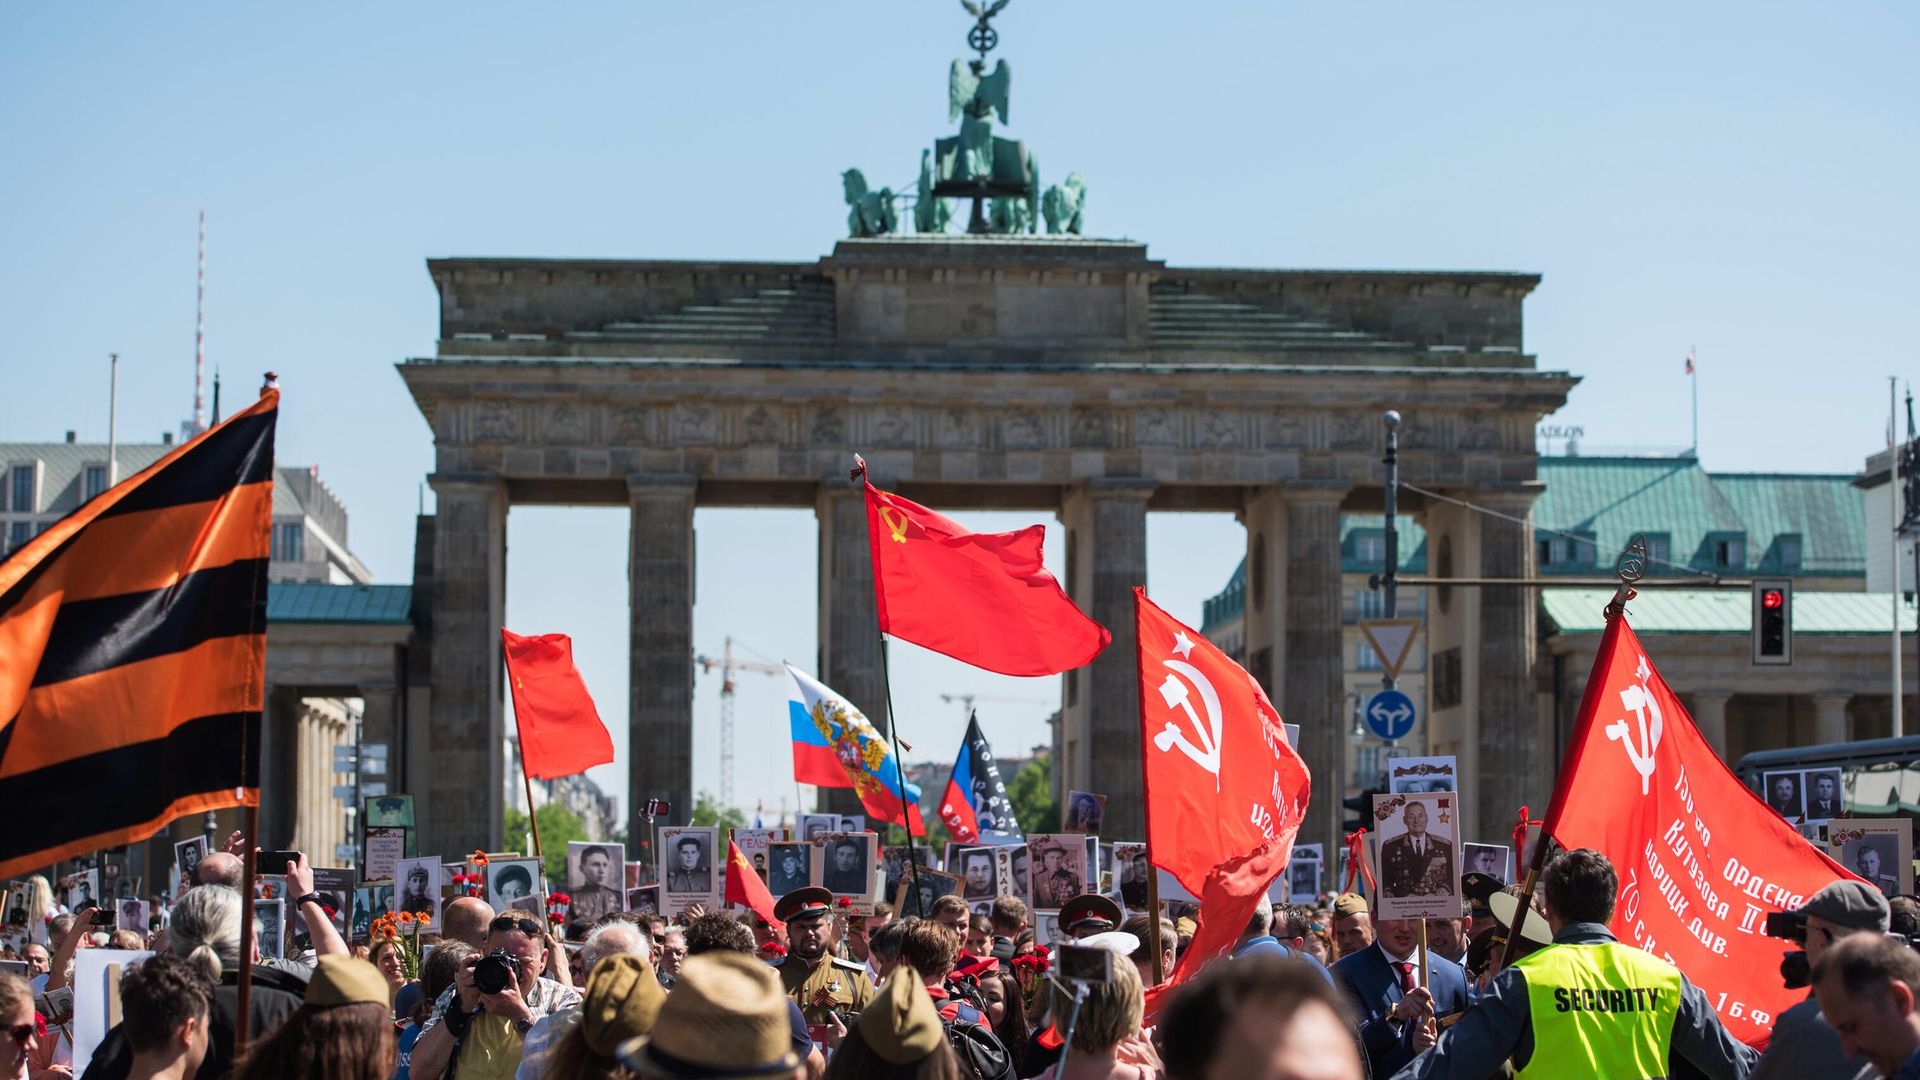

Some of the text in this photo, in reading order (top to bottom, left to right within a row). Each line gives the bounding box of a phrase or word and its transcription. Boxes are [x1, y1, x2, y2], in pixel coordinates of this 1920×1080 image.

[1645, 838, 1729, 958] ИДРИЦК. ДИВ.
[1663, 818, 1729, 921] КУТУЗОВА
[1723, 857, 1804, 912] ОРДЕНА
[1554, 987, 1659, 1013] SECURITY
